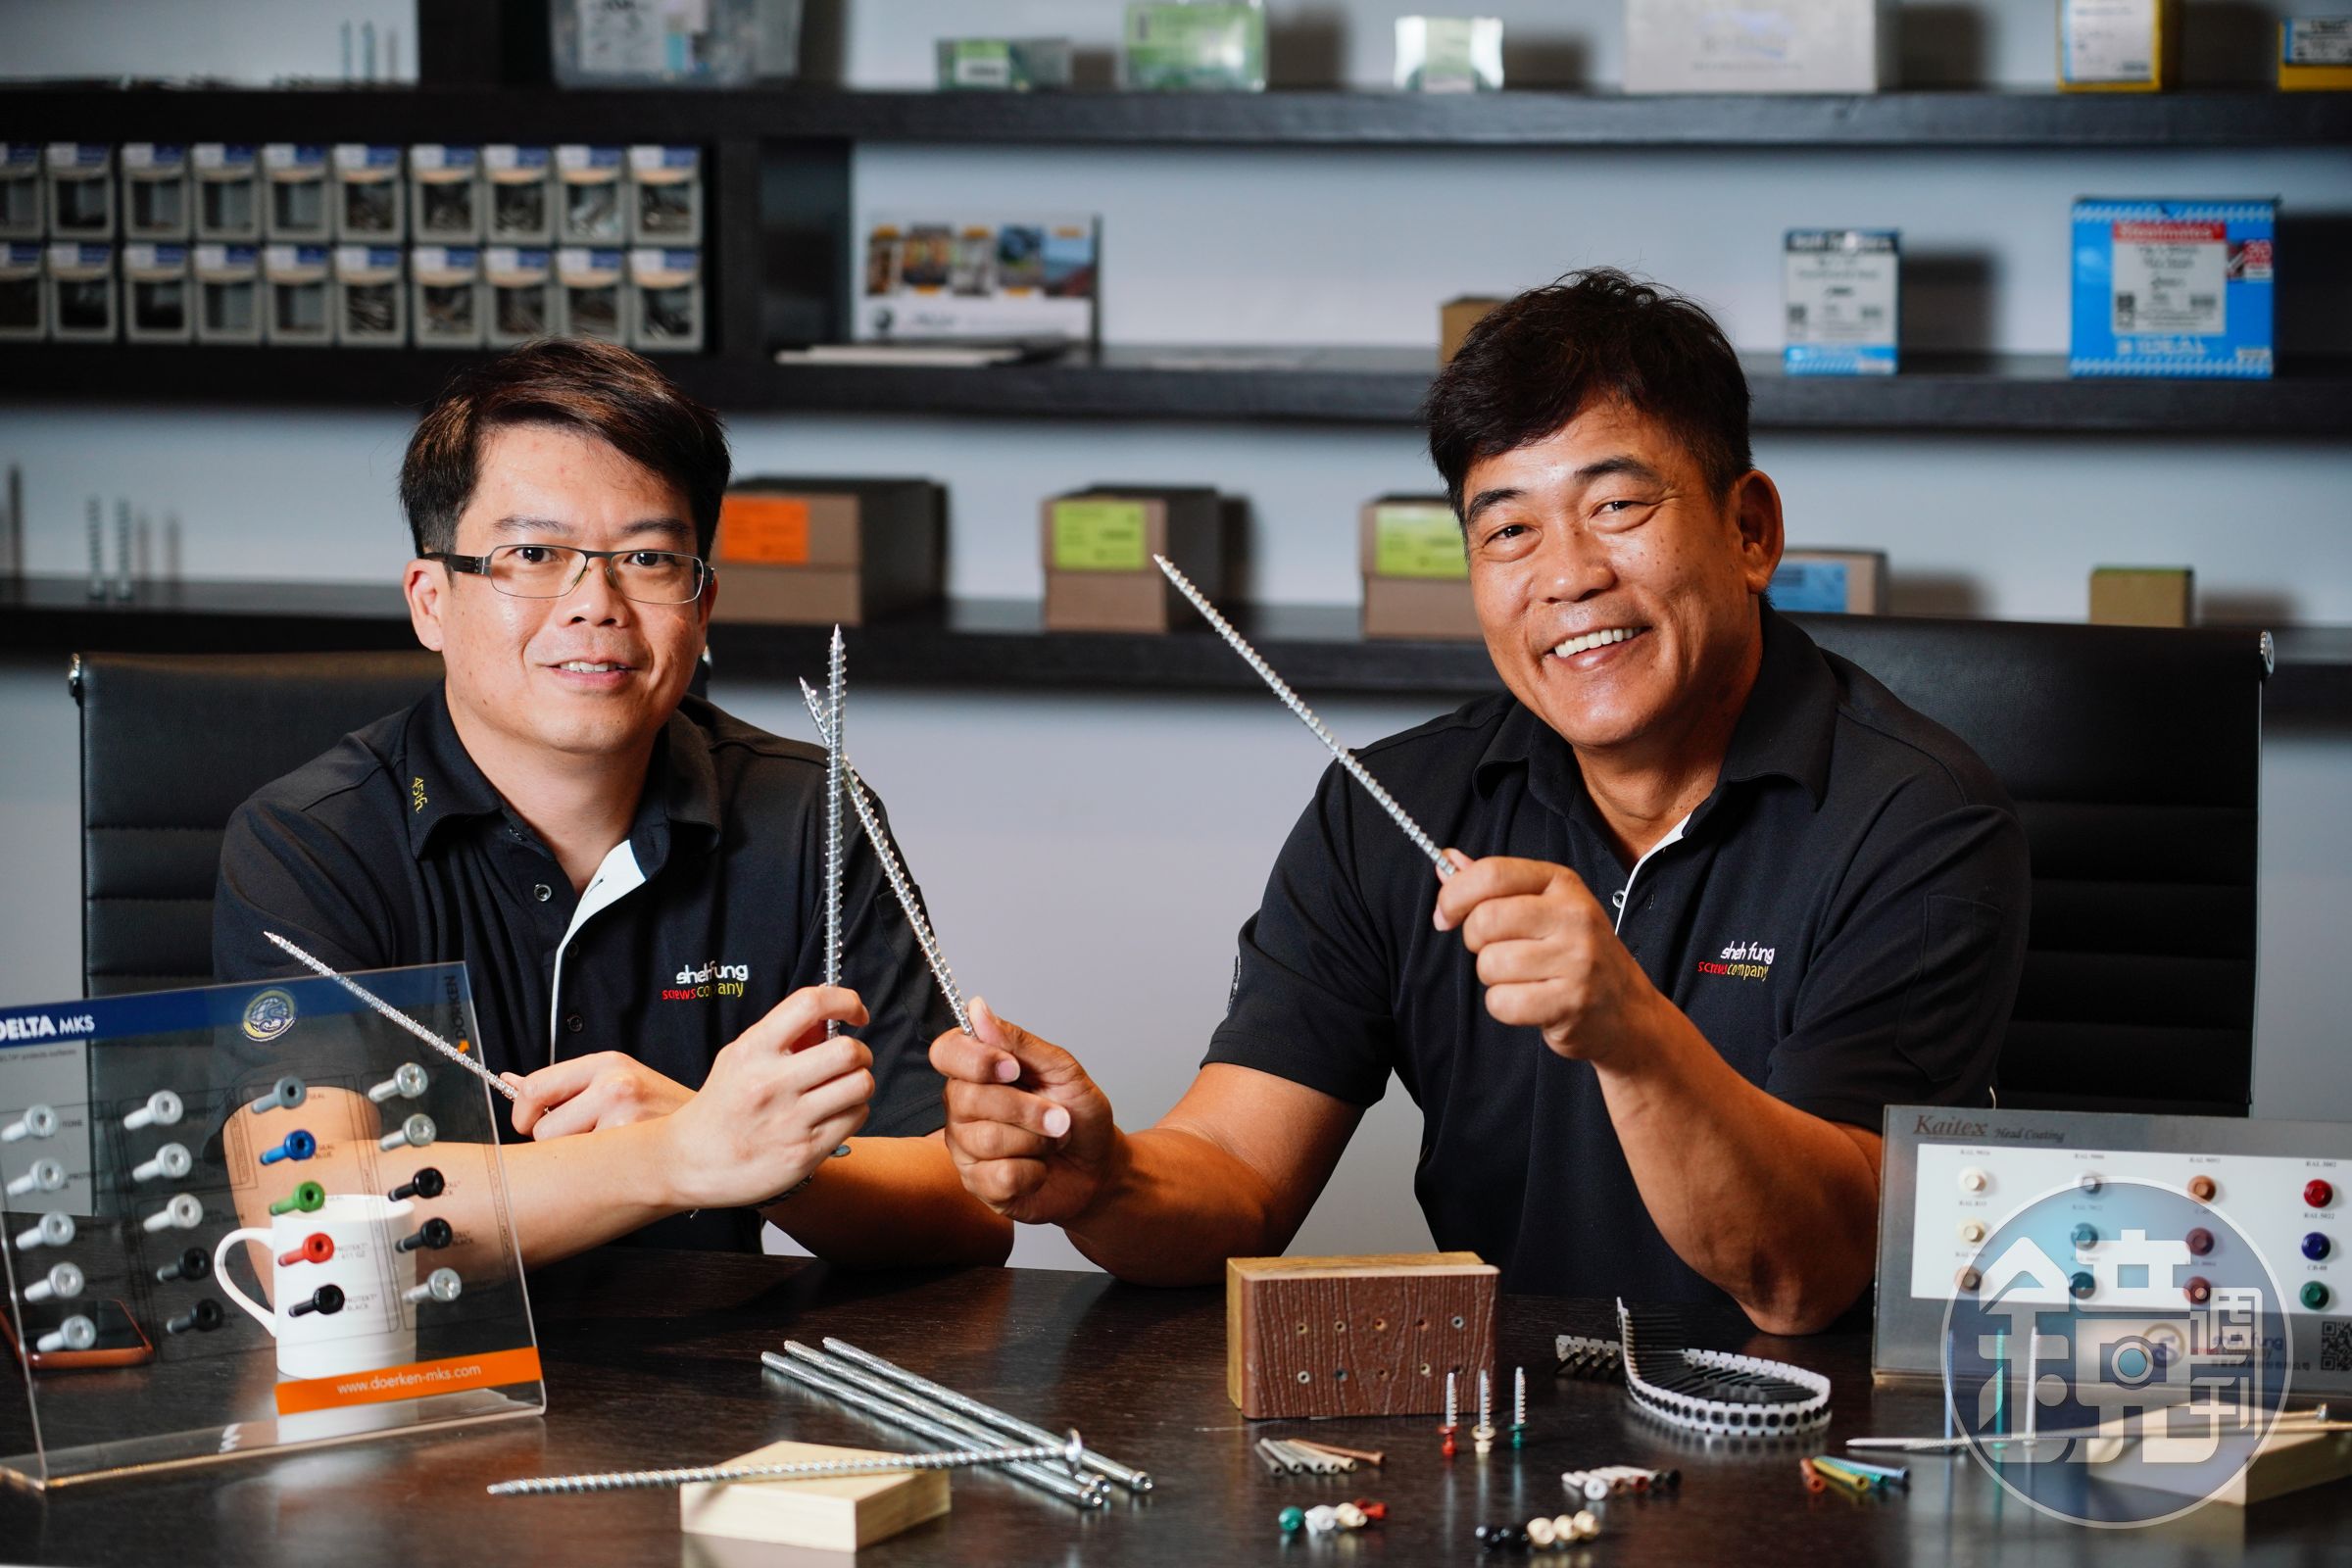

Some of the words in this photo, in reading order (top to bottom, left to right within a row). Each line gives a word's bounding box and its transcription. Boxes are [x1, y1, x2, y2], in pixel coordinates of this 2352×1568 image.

[1747, 941, 1775, 965] fung
[59, 1014, 95, 1035] MKS
[336, 1365, 482, 1395] www.doerken-mks.com
